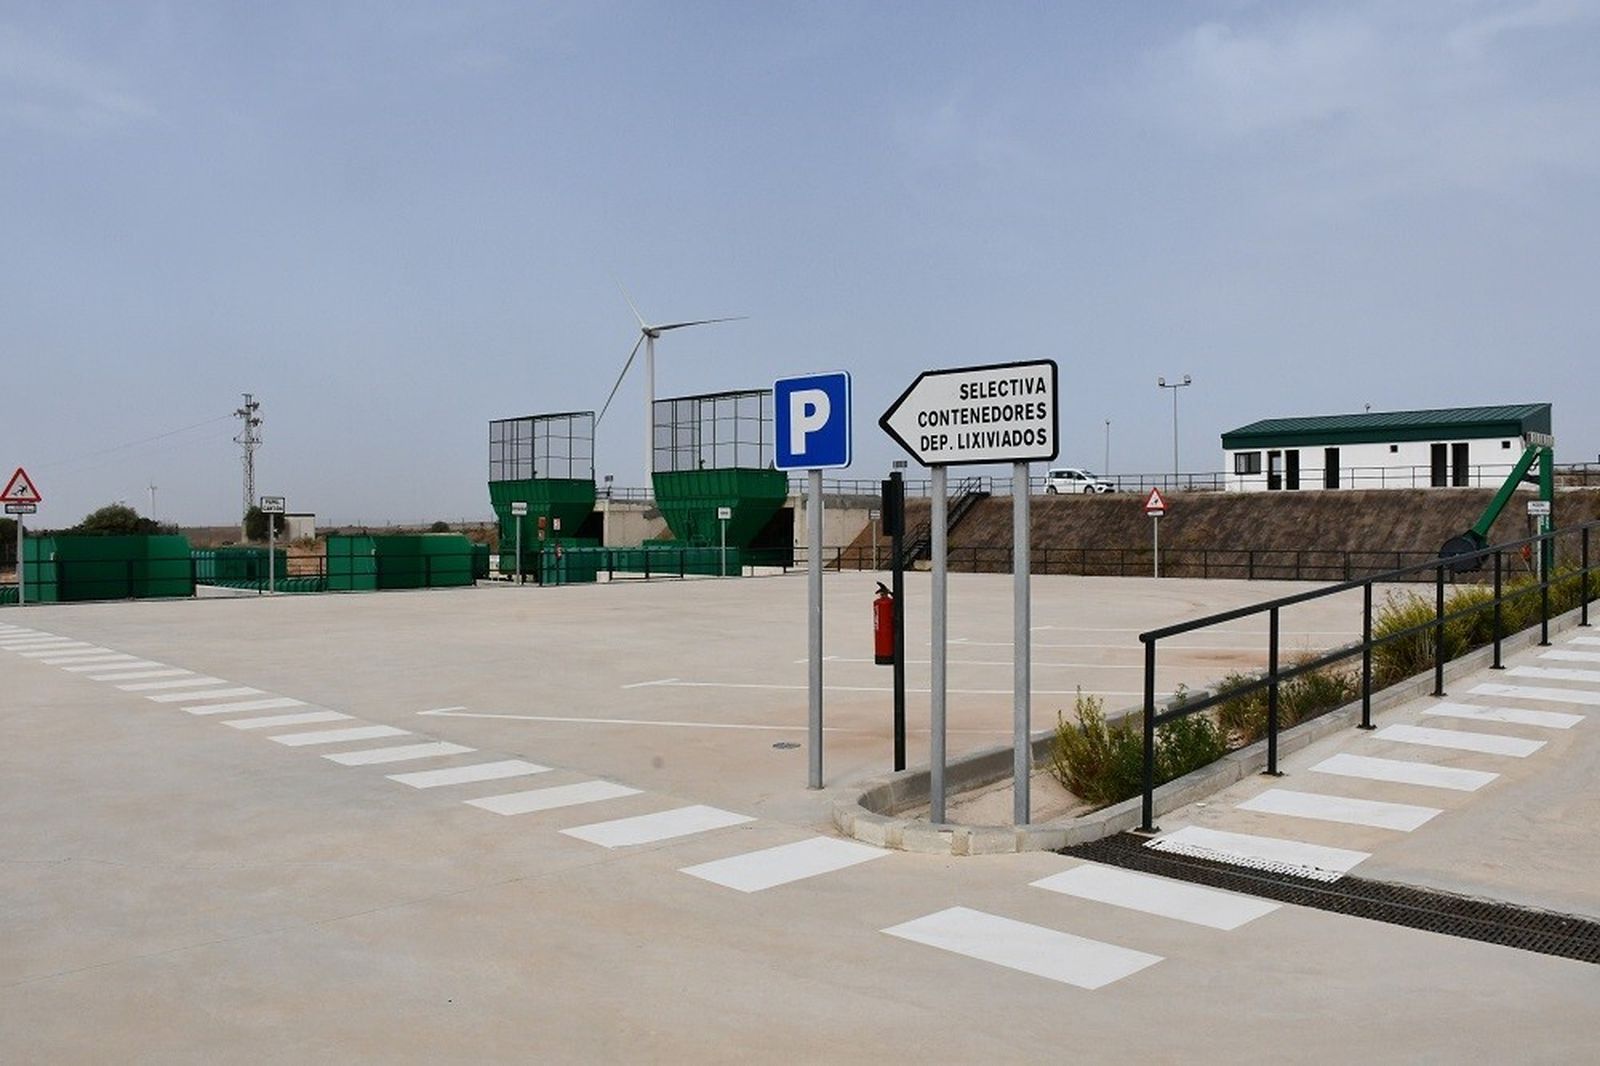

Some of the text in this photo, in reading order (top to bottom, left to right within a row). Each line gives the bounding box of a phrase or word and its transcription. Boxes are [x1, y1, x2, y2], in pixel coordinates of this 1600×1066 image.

[960, 377, 1046, 400] SELECTIVA
[790, 389, 830, 455] P
[918, 402, 1047, 427] CONTENEDORES
[920, 428, 1047, 451] DEP. LIXIVIADOS
